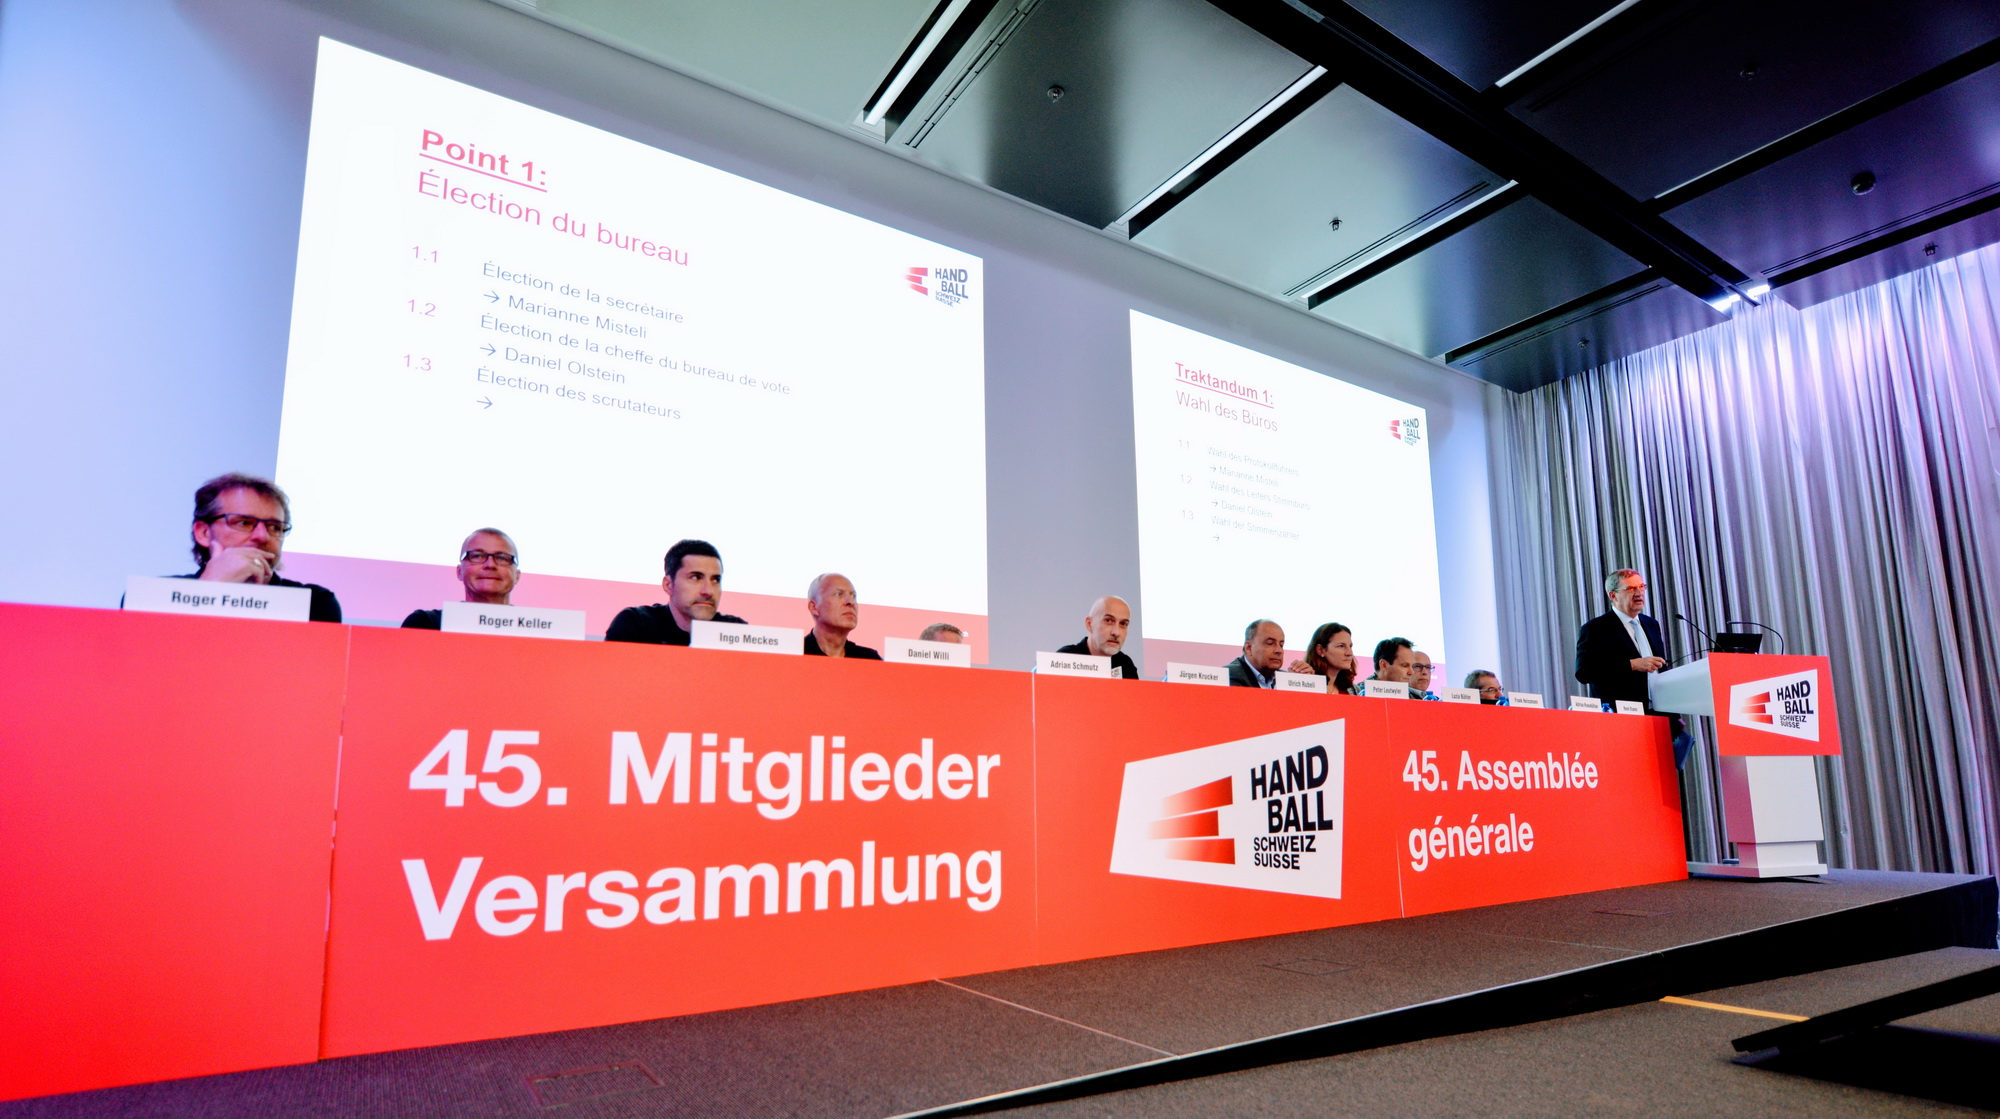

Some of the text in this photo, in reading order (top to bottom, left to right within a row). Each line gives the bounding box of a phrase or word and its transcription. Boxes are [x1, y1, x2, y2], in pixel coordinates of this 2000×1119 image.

[420, 129, 547, 187] Point 1:
[417, 168, 689, 267] Élection du bureau
[411, 245, 439, 264] 1.1
[935, 267, 968, 283] HAND
[482, 260, 684, 324] Élection de la secrétaire
[941, 280, 969, 299] BALL
[407, 298, 437, 317] 1.2
[508, 295, 647, 339] Marianne Misteli
[402, 354, 433, 372] 1.3
[480, 313, 791, 395] Élection de la cheffe du bureau de vote
[504, 346, 626, 385] Daniel Olstein
[476, 366, 682, 420] Élection des scrutateurs
[1175, 362, 1274, 405] Traktandum 1:
[1176, 390, 1278, 432] Wahl des Büros
[1402, 418, 1420, 428] HAND
[1207, 446, 1227, 459] Wahl
[1209, 480, 1229, 492] Wahl
[1211, 515, 1230, 527] Wahl
[171, 591, 269, 609] Roger Felder
[479, 614, 552, 629] Roger Keller
[719, 632, 779, 646] Ingo Meckes
[908, 648, 950, 661] Daniel Willi
[1050, 660, 1099, 671] Adrian Schmutz
[1179, 670, 1219, 681] Jürgen Krucker
[1777, 679, 1811, 701] HAND
[1784, 698, 1814, 714] BALL
[1780, 714, 1807, 723] SCHWEIZ
[1780, 721, 1800, 729] SUISSE
[409, 729, 1001, 820] 45. Mitglieder
[1250, 744, 1329, 801] HAND
[1402, 750, 1599, 792] 45. Assemblée
[1267, 790, 1334, 834] BALL
[1253, 834, 1317, 853] SCHWEIZ
[1408, 813, 1534, 872] générale
[1254, 852, 1301, 871] SUISSE
[401, 840, 1002, 941] Versammlung
